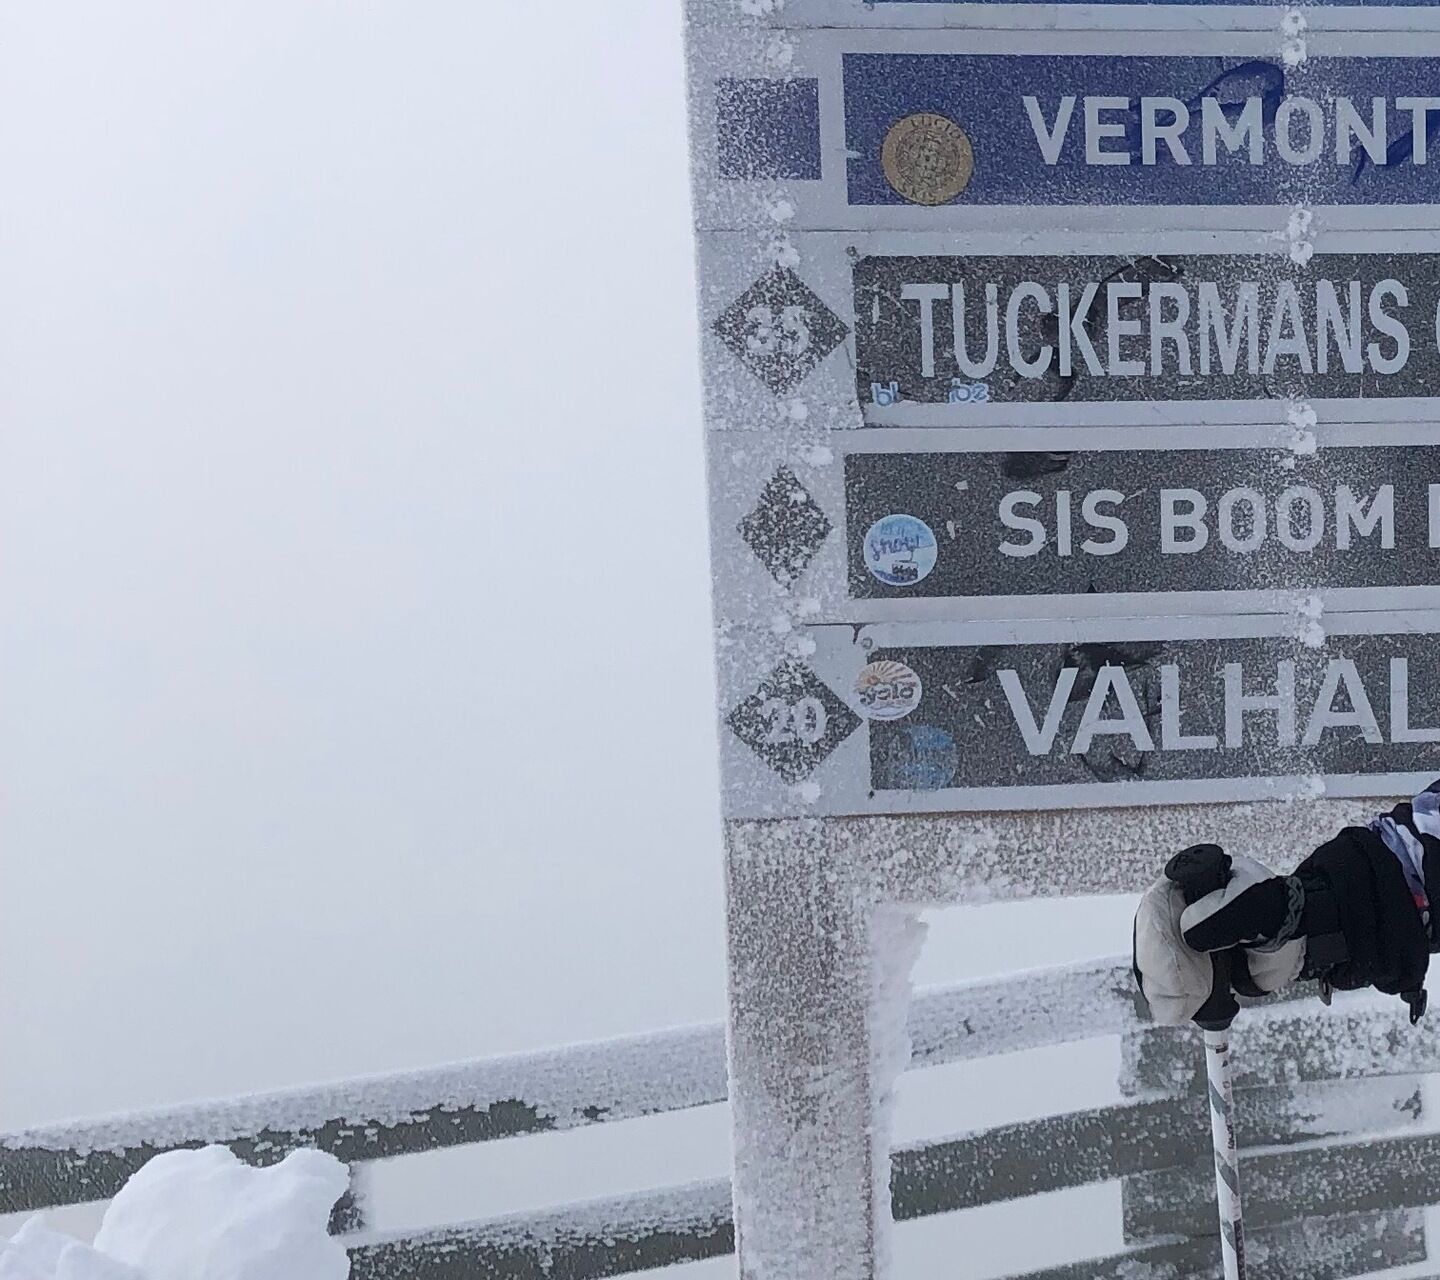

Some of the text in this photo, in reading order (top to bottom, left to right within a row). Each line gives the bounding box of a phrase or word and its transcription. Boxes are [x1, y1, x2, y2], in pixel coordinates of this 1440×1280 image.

[900, 277, 1410, 379] TUCKERMANS
[998, 487, 1130, 558] SIS
[1160, 483, 1396, 555] BOOM
